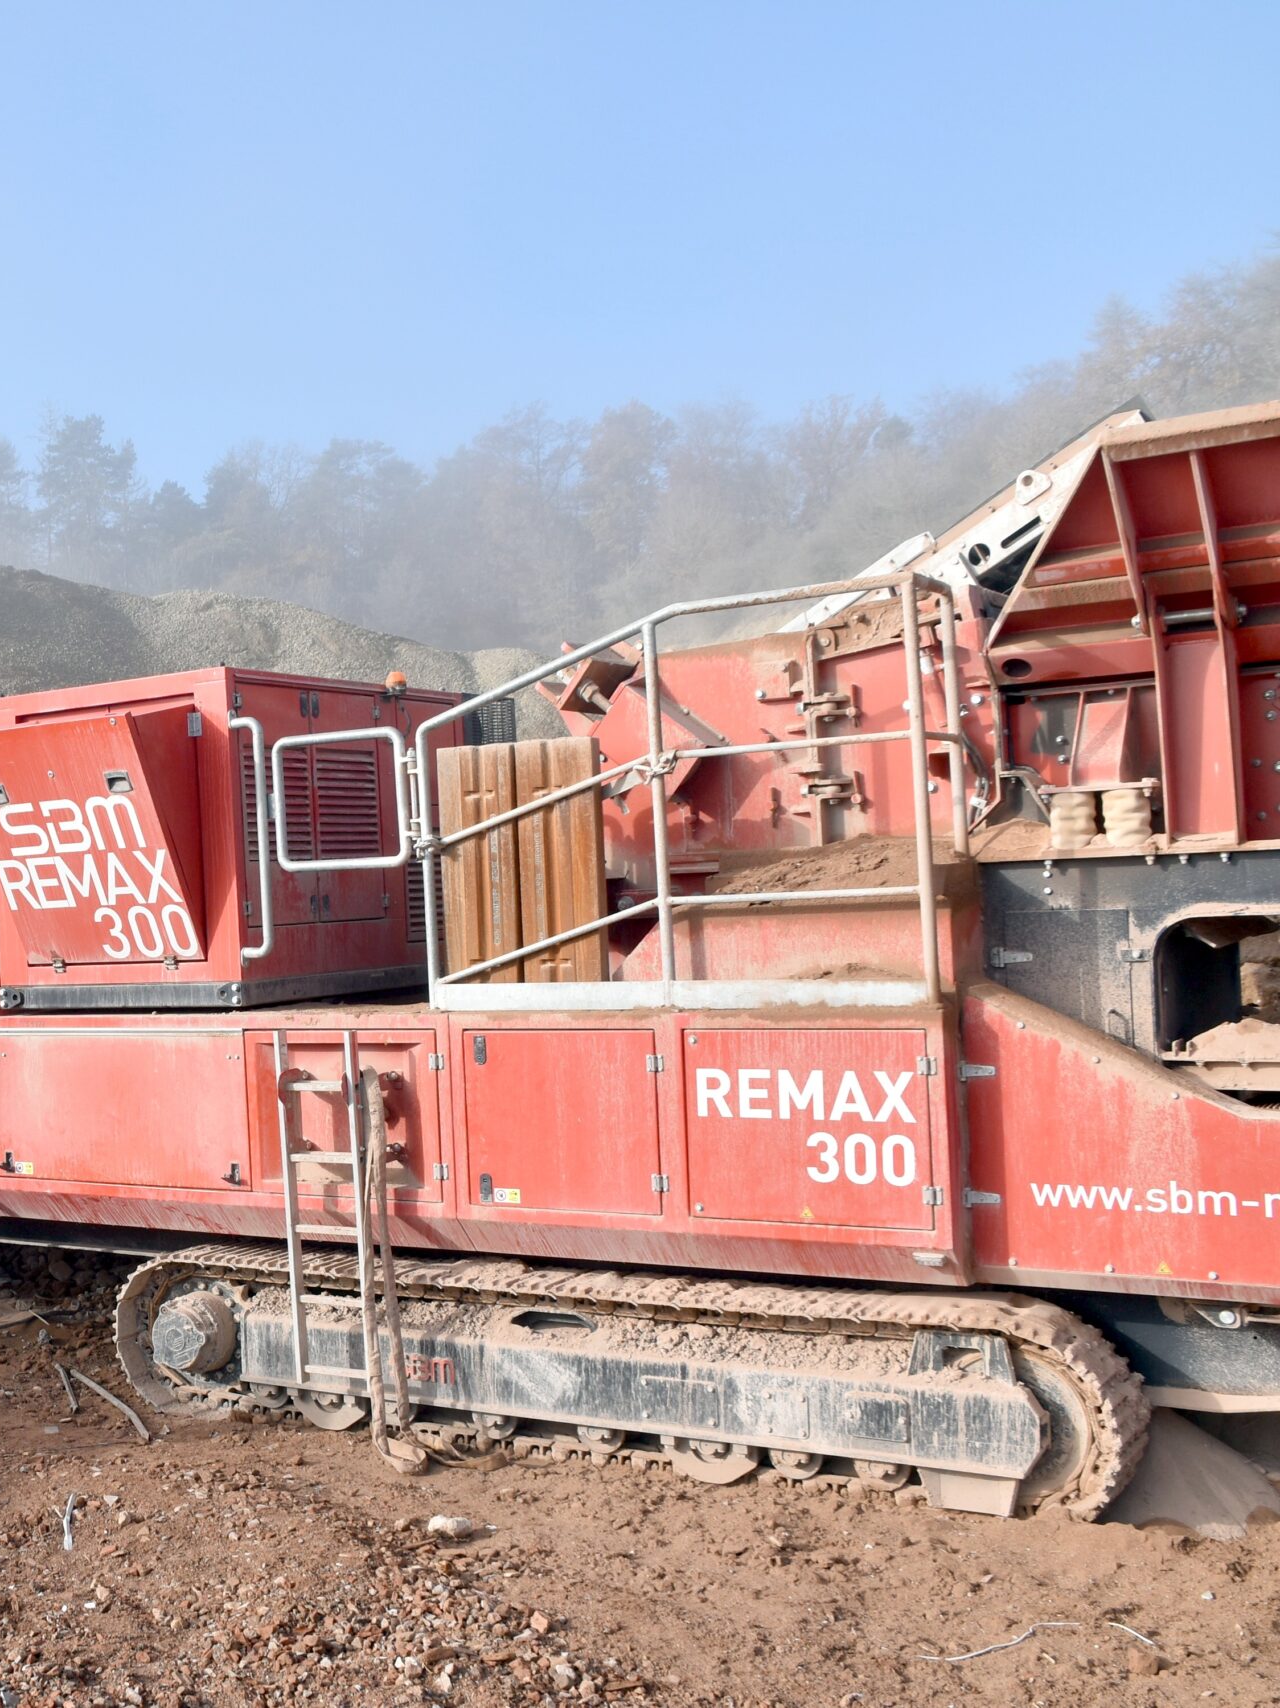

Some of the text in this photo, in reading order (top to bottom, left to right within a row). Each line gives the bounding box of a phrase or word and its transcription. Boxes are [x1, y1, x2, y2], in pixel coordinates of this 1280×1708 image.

[94, 904, 199, 959] 300
[695, 1068, 918, 1123] REMAX
[806, 1131, 917, 1187] 300
